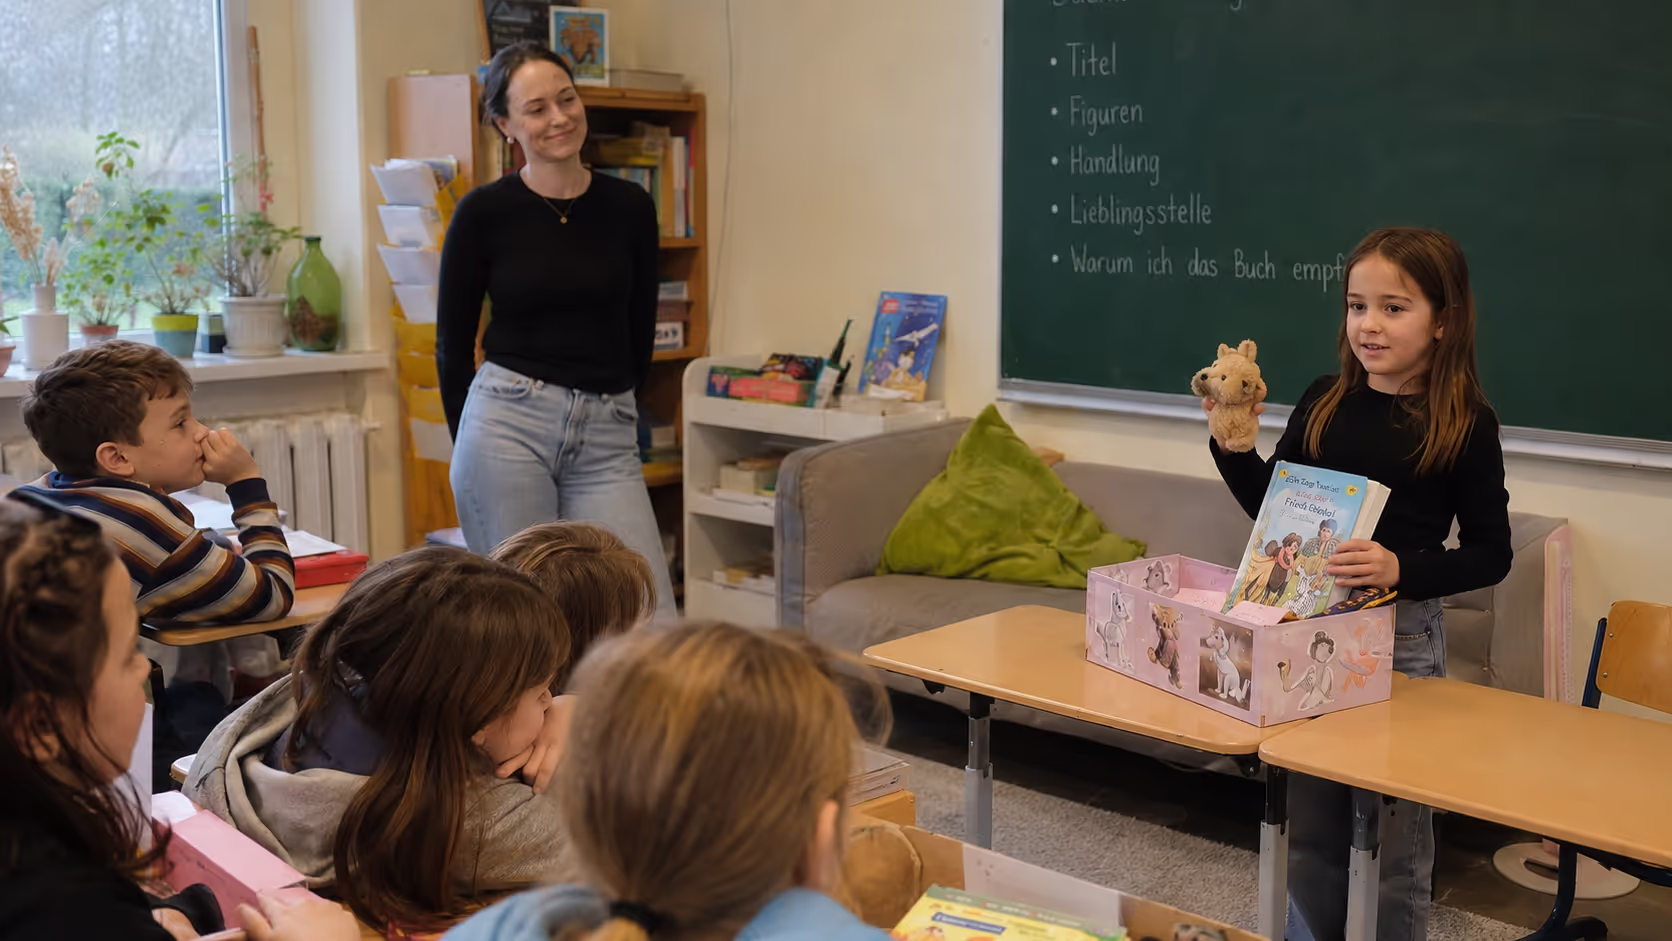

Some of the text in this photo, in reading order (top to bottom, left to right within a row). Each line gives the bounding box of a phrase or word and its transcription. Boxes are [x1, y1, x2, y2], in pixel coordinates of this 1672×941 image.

[1065, 41, 1116, 77] Titel
[1069, 94, 1144, 137] Figuren
[1070, 143, 1160, 186] Handlung
[1070, 193, 1213, 235] Lieblingsstelle
[1070, 243, 1347, 293] Warum ich das Buch empf
